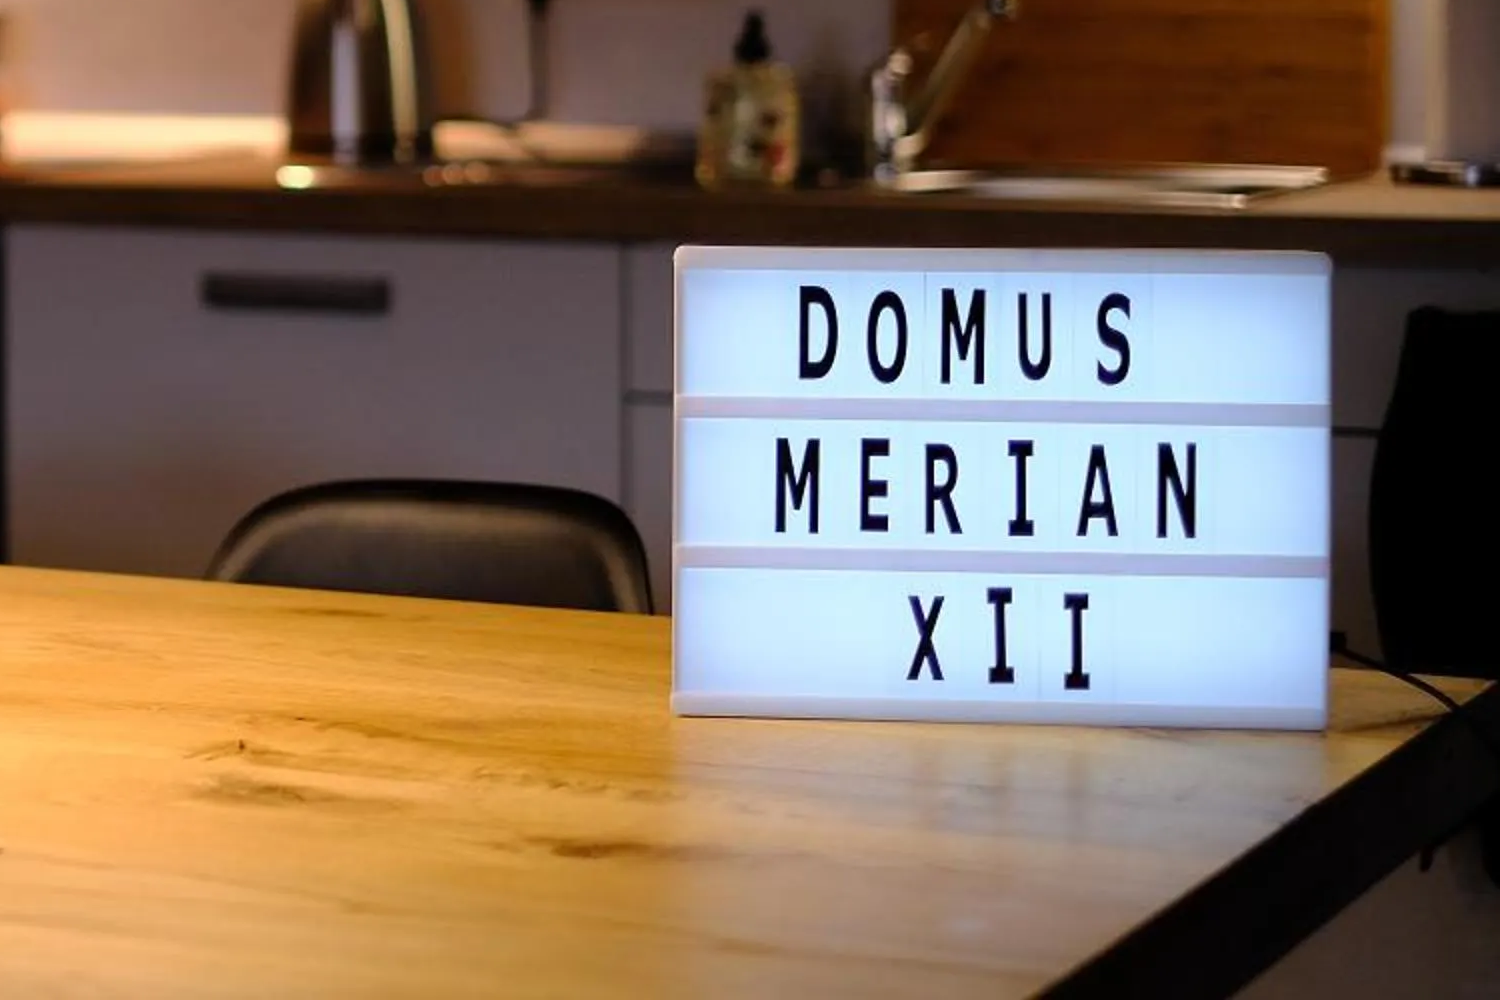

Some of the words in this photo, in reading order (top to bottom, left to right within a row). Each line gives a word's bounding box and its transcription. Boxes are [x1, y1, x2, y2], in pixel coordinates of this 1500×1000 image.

[798, 285, 1132, 386] DOMUS
[774, 437, 1198, 539] MERIAN
[906, 587, 1091, 690] XII
